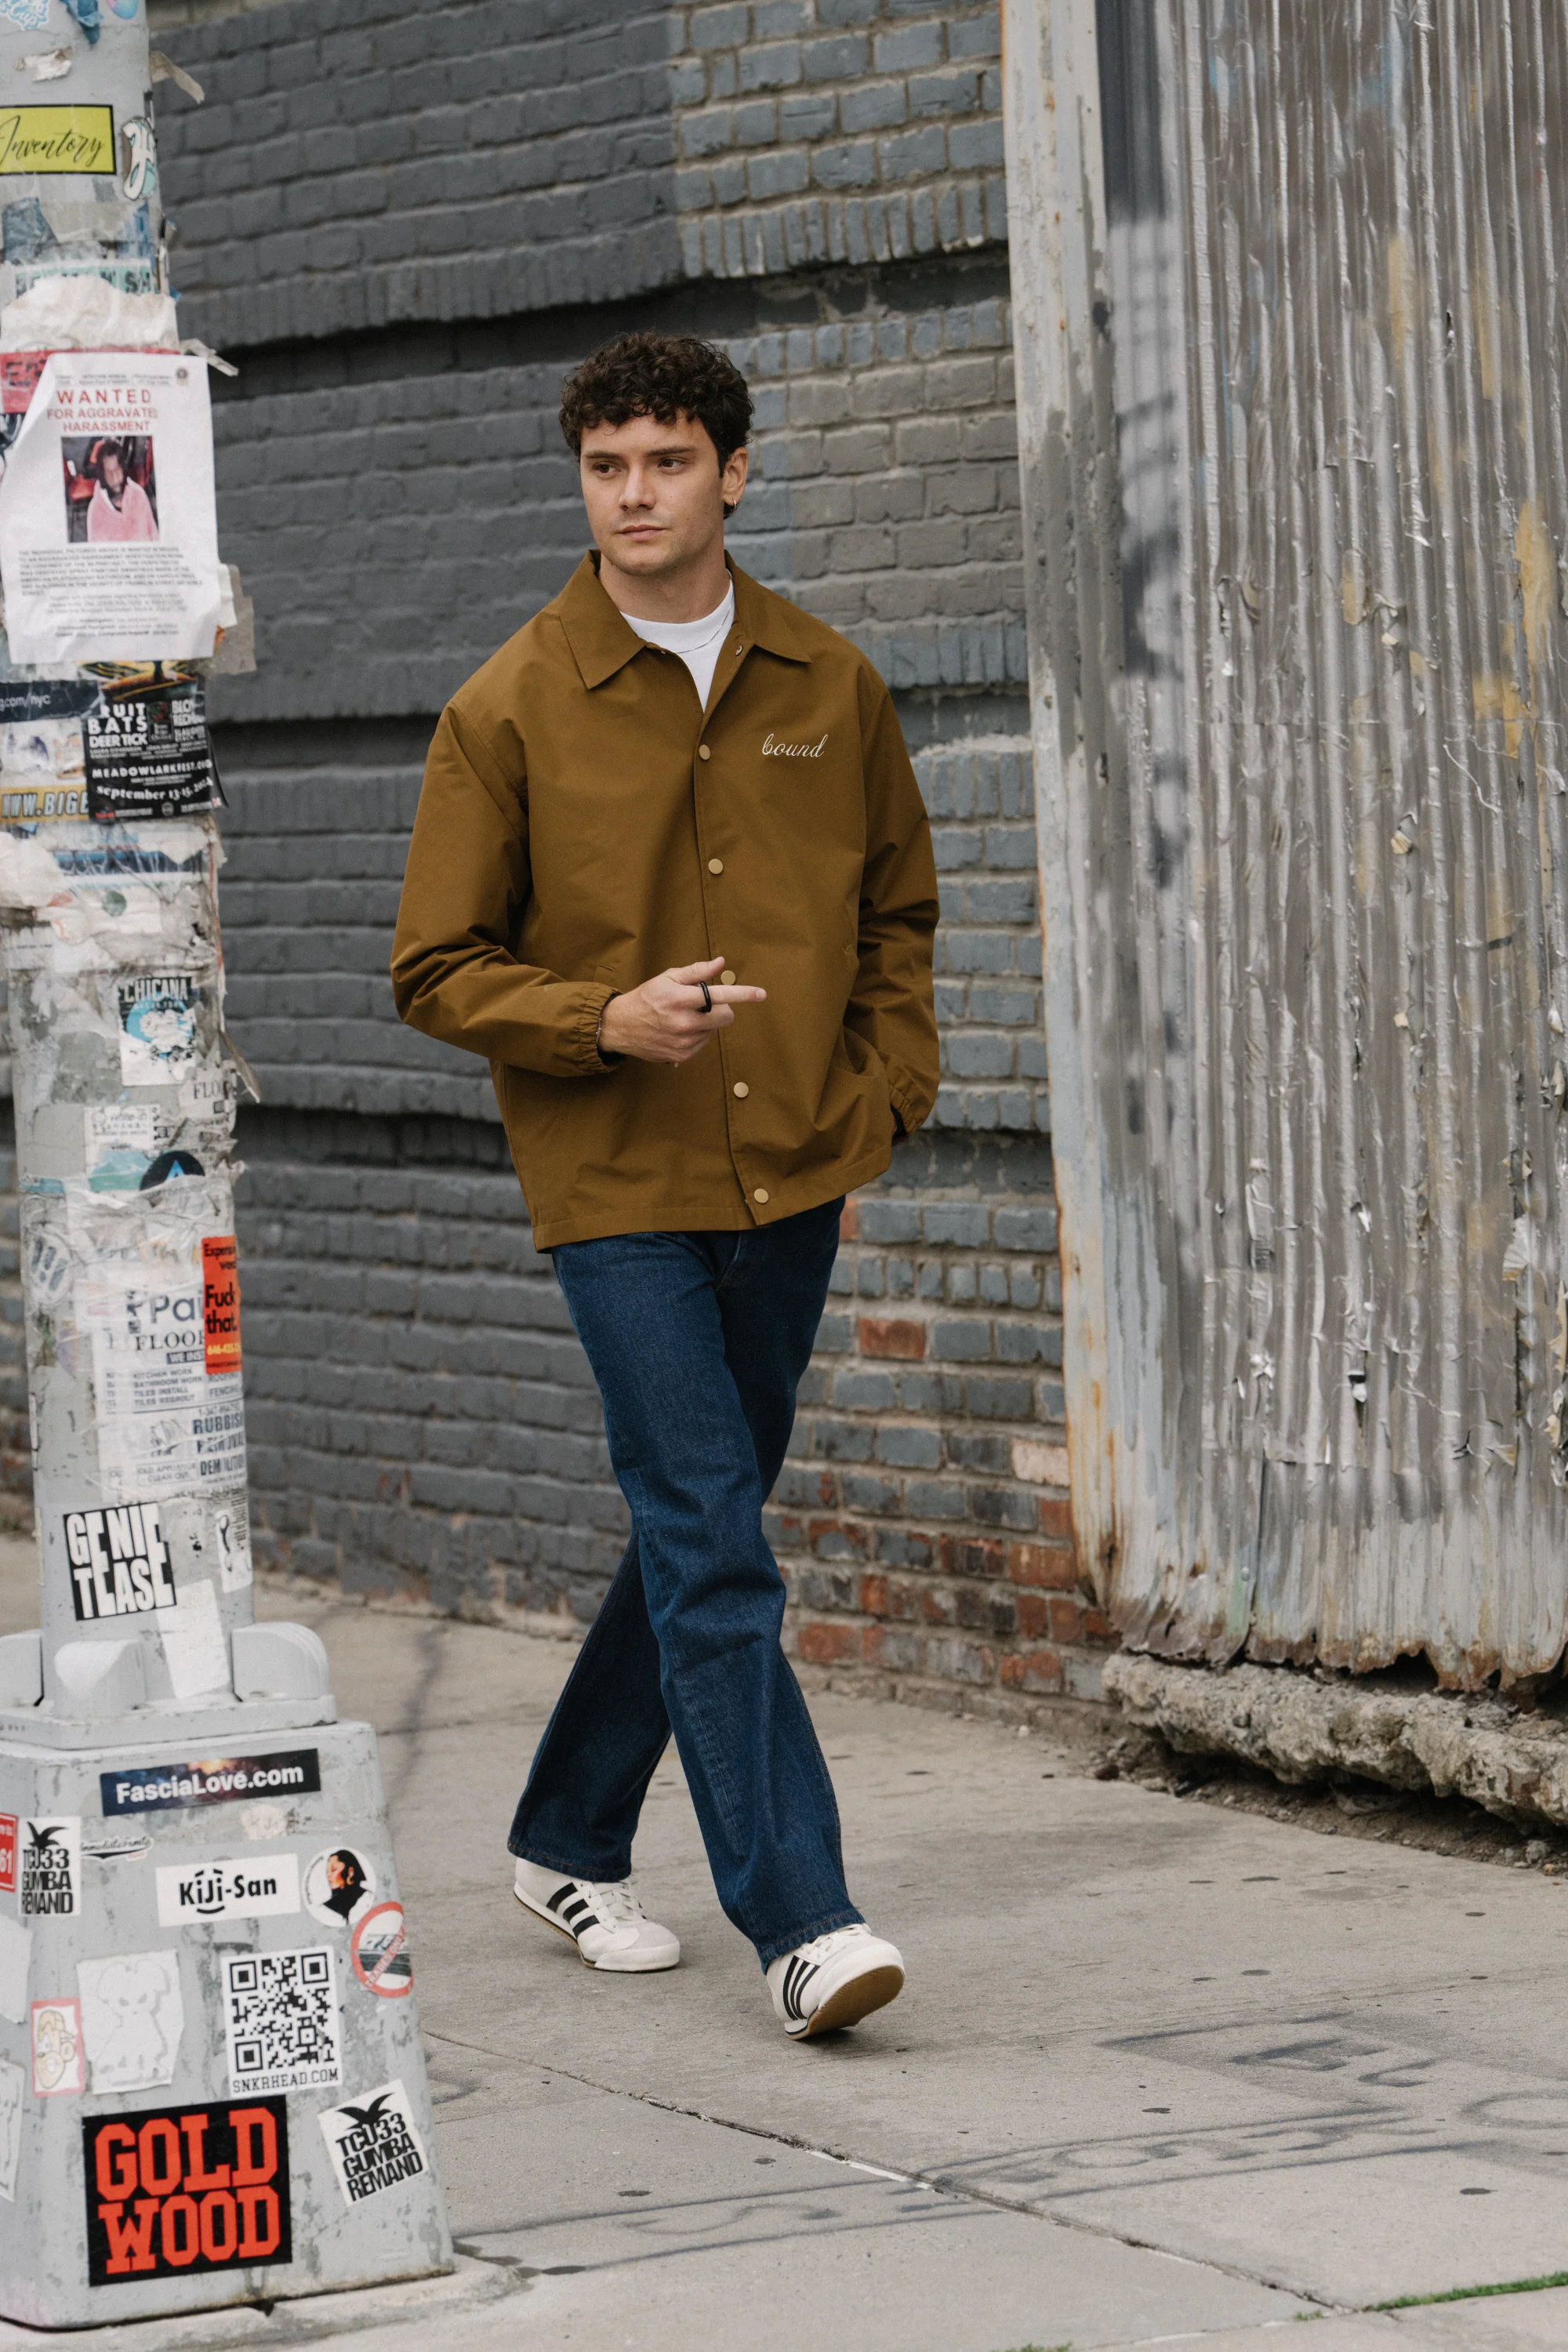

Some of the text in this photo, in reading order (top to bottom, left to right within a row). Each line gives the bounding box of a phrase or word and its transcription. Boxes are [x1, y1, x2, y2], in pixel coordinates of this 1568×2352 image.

[0, 115, 104, 167] Inventory
[56, 389, 151, 404] WANTED
[46, 408, 74, 419] FOR
[63, 420, 151, 432] HARASSMENT
[100, 702, 146, 719] RUIT
[87, 715, 148, 735] BATS
[89, 732, 148, 749] DEER TICK
[762, 733, 828, 757] bound
[124, 978, 188, 1003] CHICANA
[133, 1378, 178, 1388] BATHROOM
[115, 1764, 304, 1804] FasciaLove.com
[22, 1871, 71, 1890] GUMBA
[22, 1892, 74, 1915] REMAND
[233, 2068, 339, 2092] SNKRHEAD.COM
[336, 2113, 406, 2158] TCU33
[95, 2107, 278, 2202] GOLD
[343, 2132, 416, 2179] GUMBA
[347, 2151, 423, 2202] REMAND
[97, 2185, 281, 2274] WOOD
